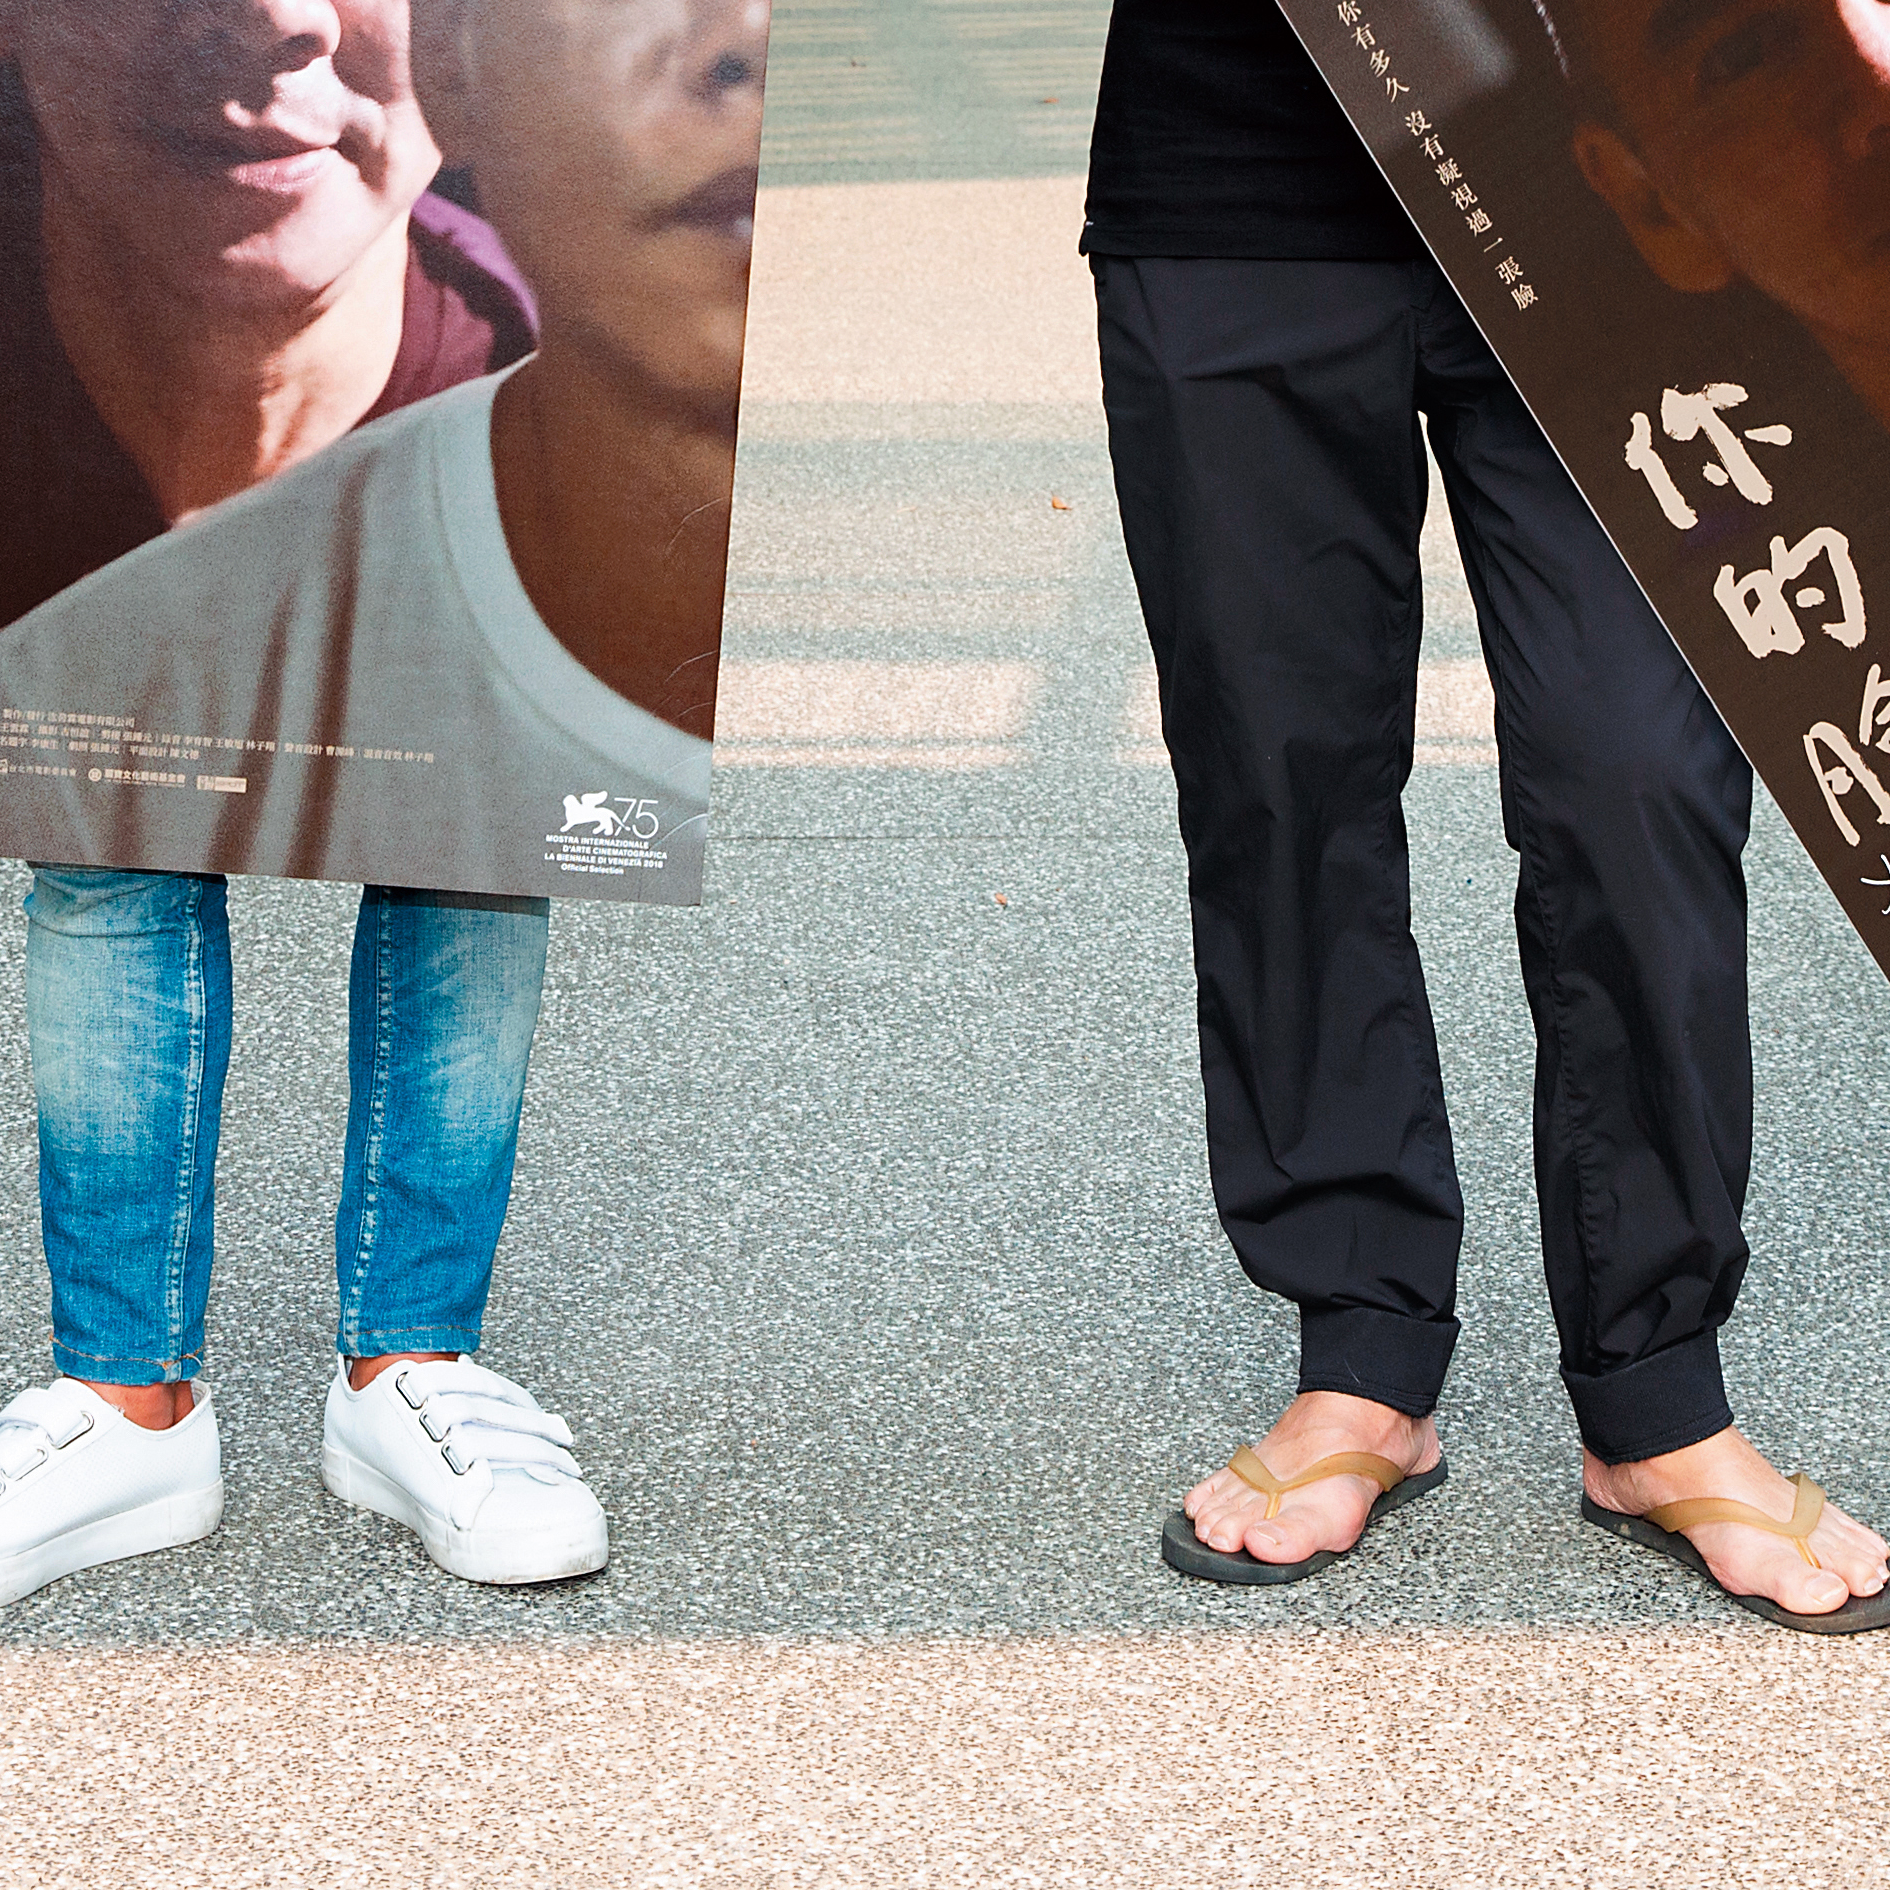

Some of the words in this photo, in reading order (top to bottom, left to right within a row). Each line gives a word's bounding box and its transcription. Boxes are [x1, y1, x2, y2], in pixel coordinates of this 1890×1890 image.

[1337, 0, 1409, 102] 你有多久
[1404, 110, 1537, 309] 沒有凝視過一張臉
[611, 796, 661, 840] 75
